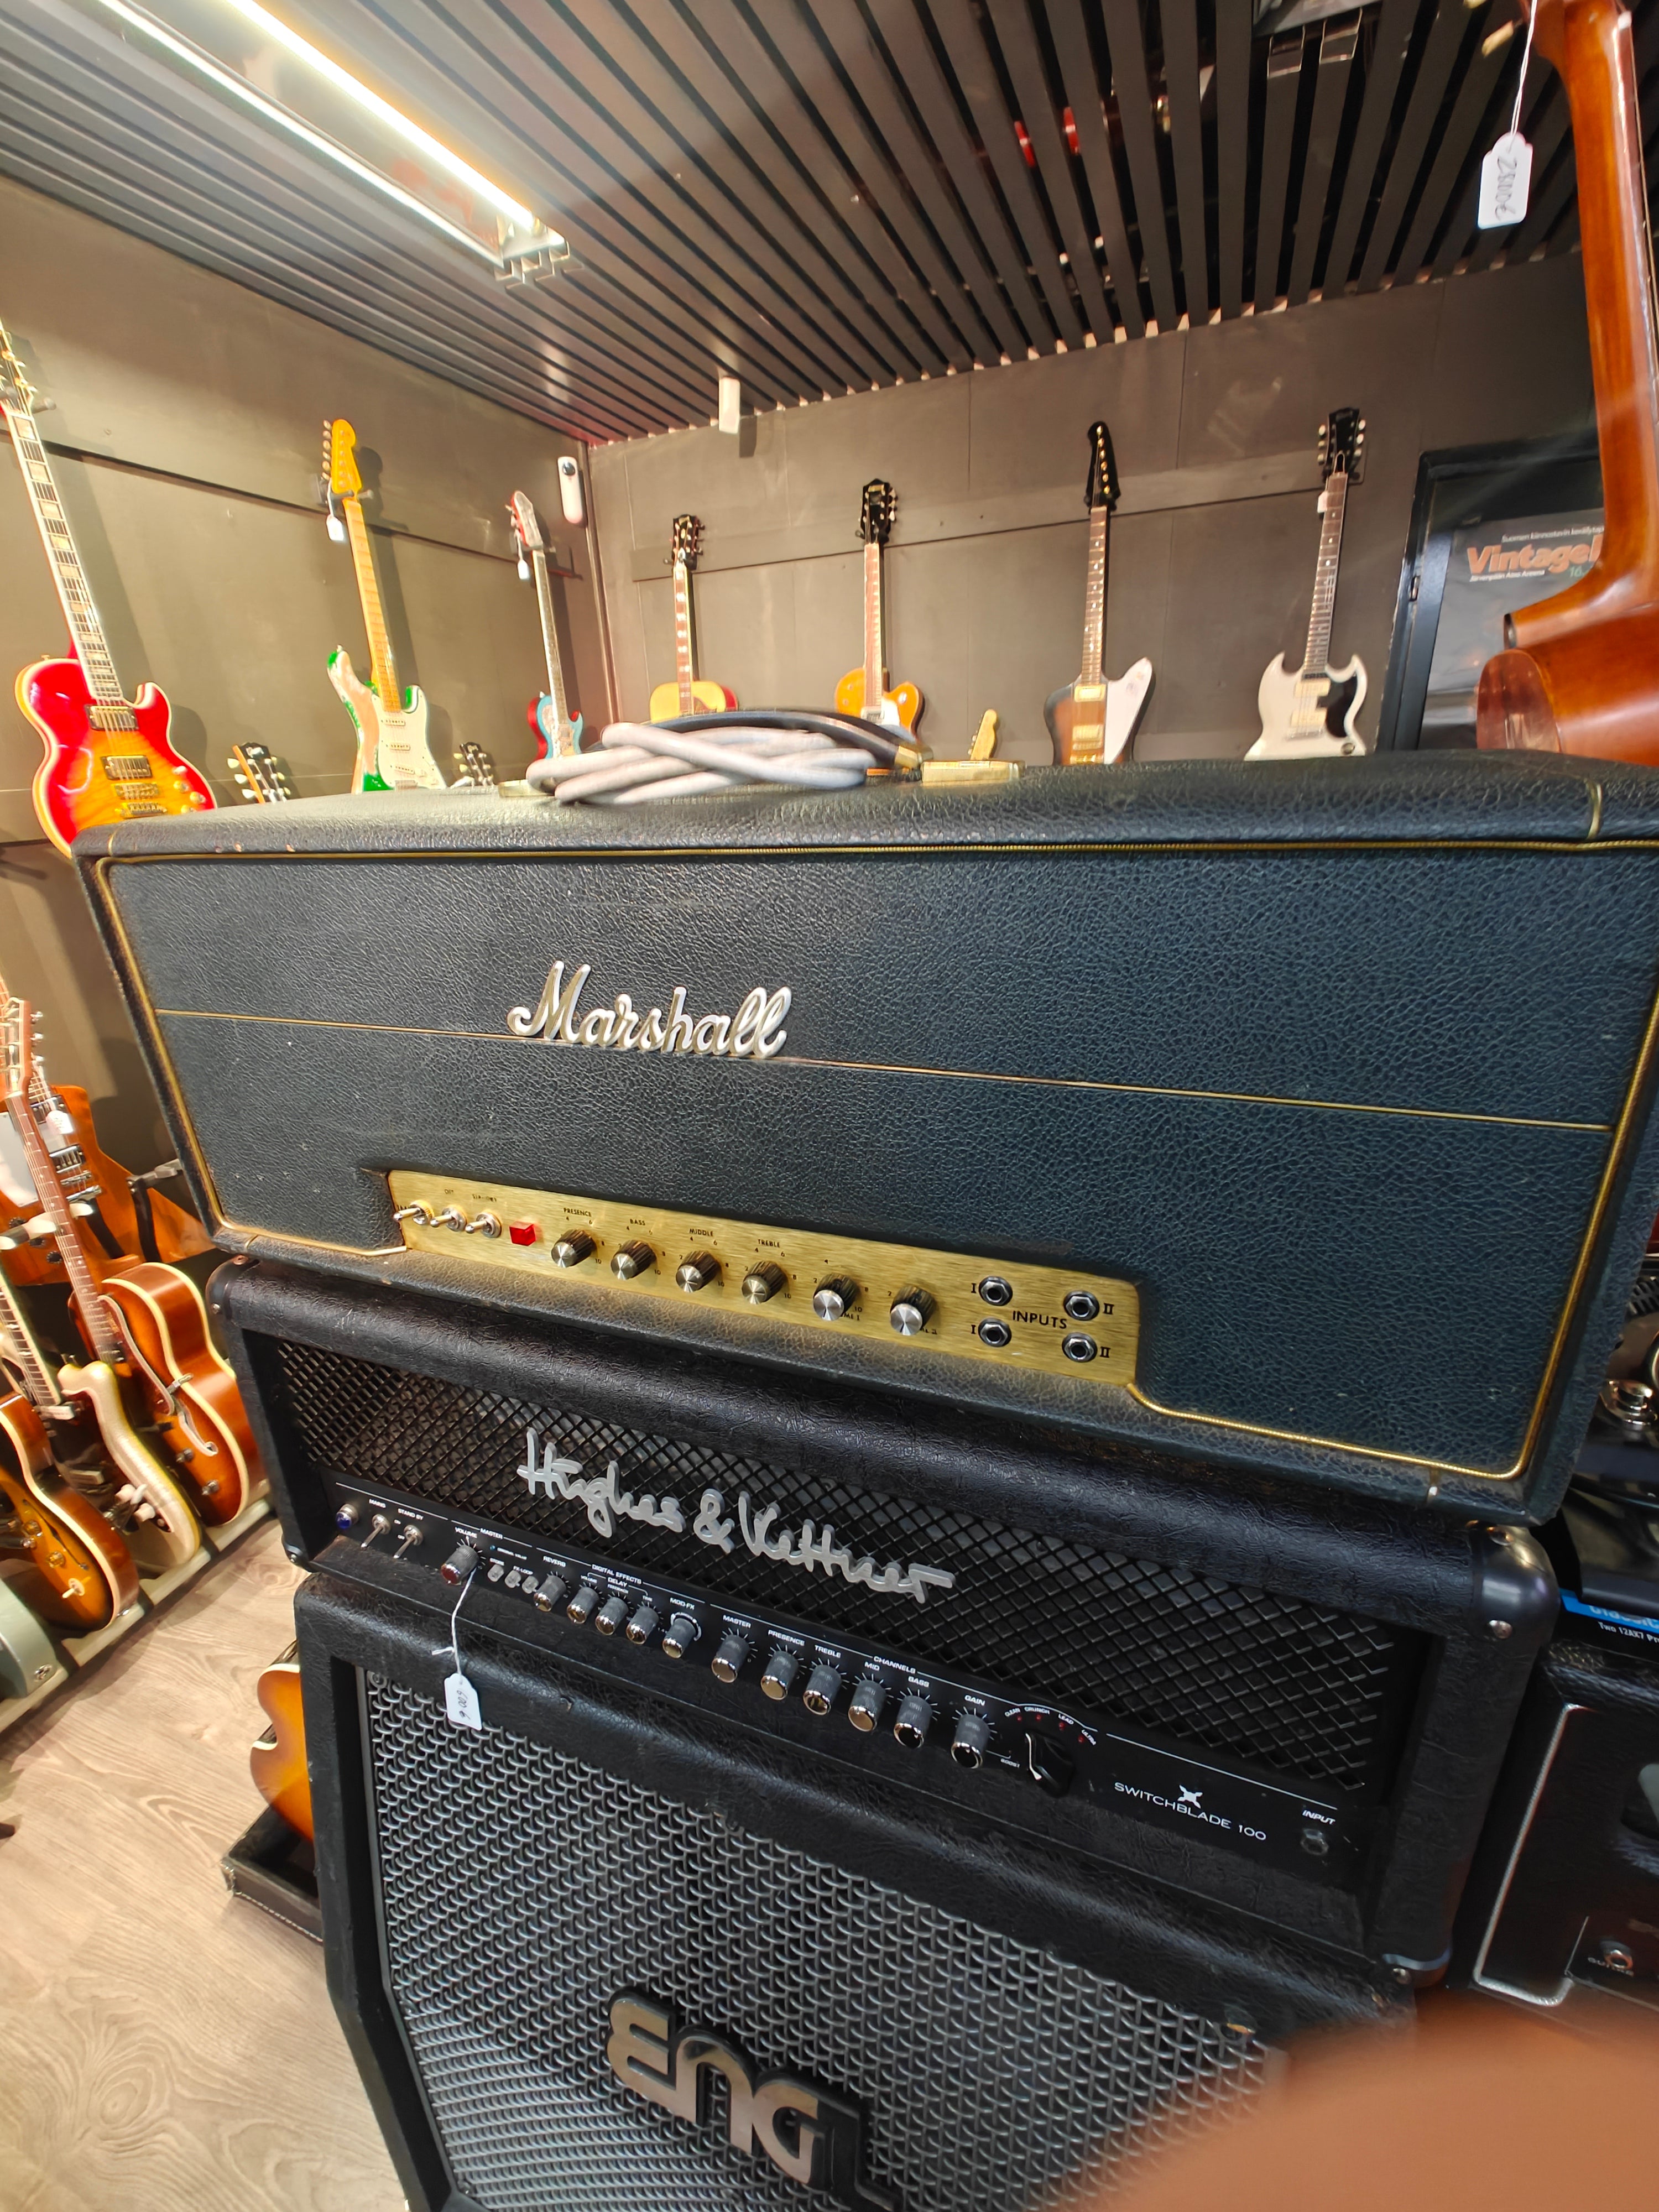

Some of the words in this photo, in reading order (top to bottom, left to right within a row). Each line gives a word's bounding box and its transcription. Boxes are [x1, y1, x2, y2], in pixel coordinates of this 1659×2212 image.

[507, 960, 791, 1058] Marshall
[563, 1207, 592, 1217] PRESENCE
[689, 1228, 713, 1237] MIDDLE
[757, 1239, 780, 1248] TREBLE
[1012, 1310, 1067, 1329] INPUTS
[398, 1508, 415, 1518] STAND
[517, 1427, 687, 1538] Hughes
[693, 1488, 735, 1554] &
[738, 1491, 956, 1604] Kettner
[455, 1526, 477, 1538] VOLUME
[480, 1528, 503, 1540] MASTER
[543, 1556, 566, 1567] REVERB
[592, 1564, 614, 1576] DIGITAL
[615, 1572, 641, 1584] EFFECTS
[608, 1577, 627, 1587] DELAY
[670, 1597, 686, 1607] MOD
[723, 1614, 751, 1628] MASTER
[1598, 1621, 1616, 1632] Two
[1619, 1626, 1644, 1640] 12AX7
[768, 1629, 805, 1646] PRESENCE
[815, 1644, 841, 1658] TREBLE
[864, 1661, 880, 1671] MID
[873, 1656, 916, 1674] CHANNELS
[908, 1676, 930, 1687] BASS
[964, 1695, 985, 1706] GAIN
[1004, 1707, 1021, 1717] CLEAN
[1024, 1707, 1050, 1715] CRUNCH
[1058, 1714, 1074, 1725] LEAD
[1081, 1729, 1097, 1746] ULTRA
[1000, 1758, 1020, 1768] BOOST
[1114, 1782, 1231, 1829] SWITCHBLADE
[1238, 1824, 1267, 1841] 100
[1302, 1809, 1336, 1825] INPUT
